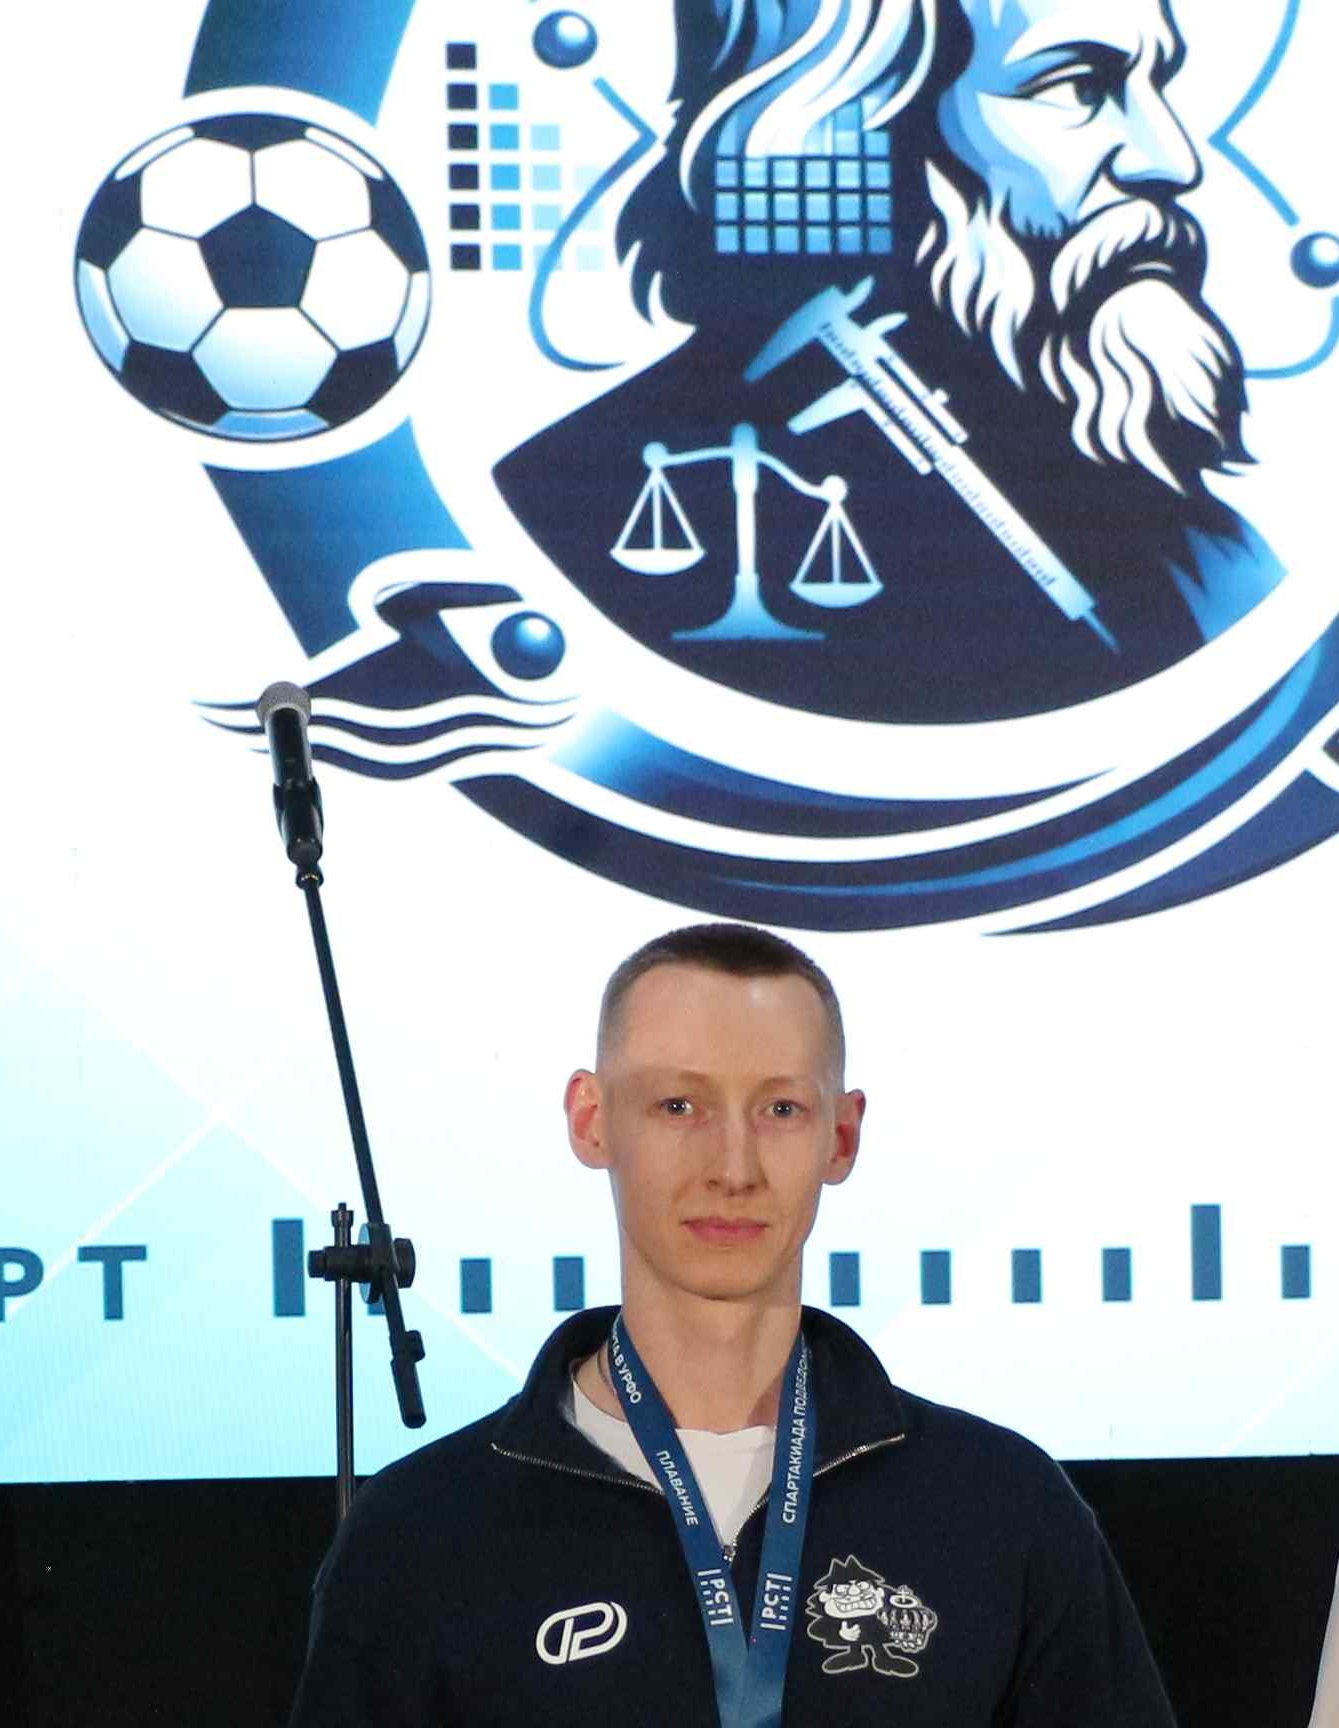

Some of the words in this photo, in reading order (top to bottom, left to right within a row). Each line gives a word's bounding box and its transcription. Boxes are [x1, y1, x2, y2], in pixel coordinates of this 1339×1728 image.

[619, 1366, 642, 1404] УРФО
[656, 1450, 700, 1527] ПЛАВАНИЕ
[783, 1418, 805, 1524] СПАРТАКИАДА
